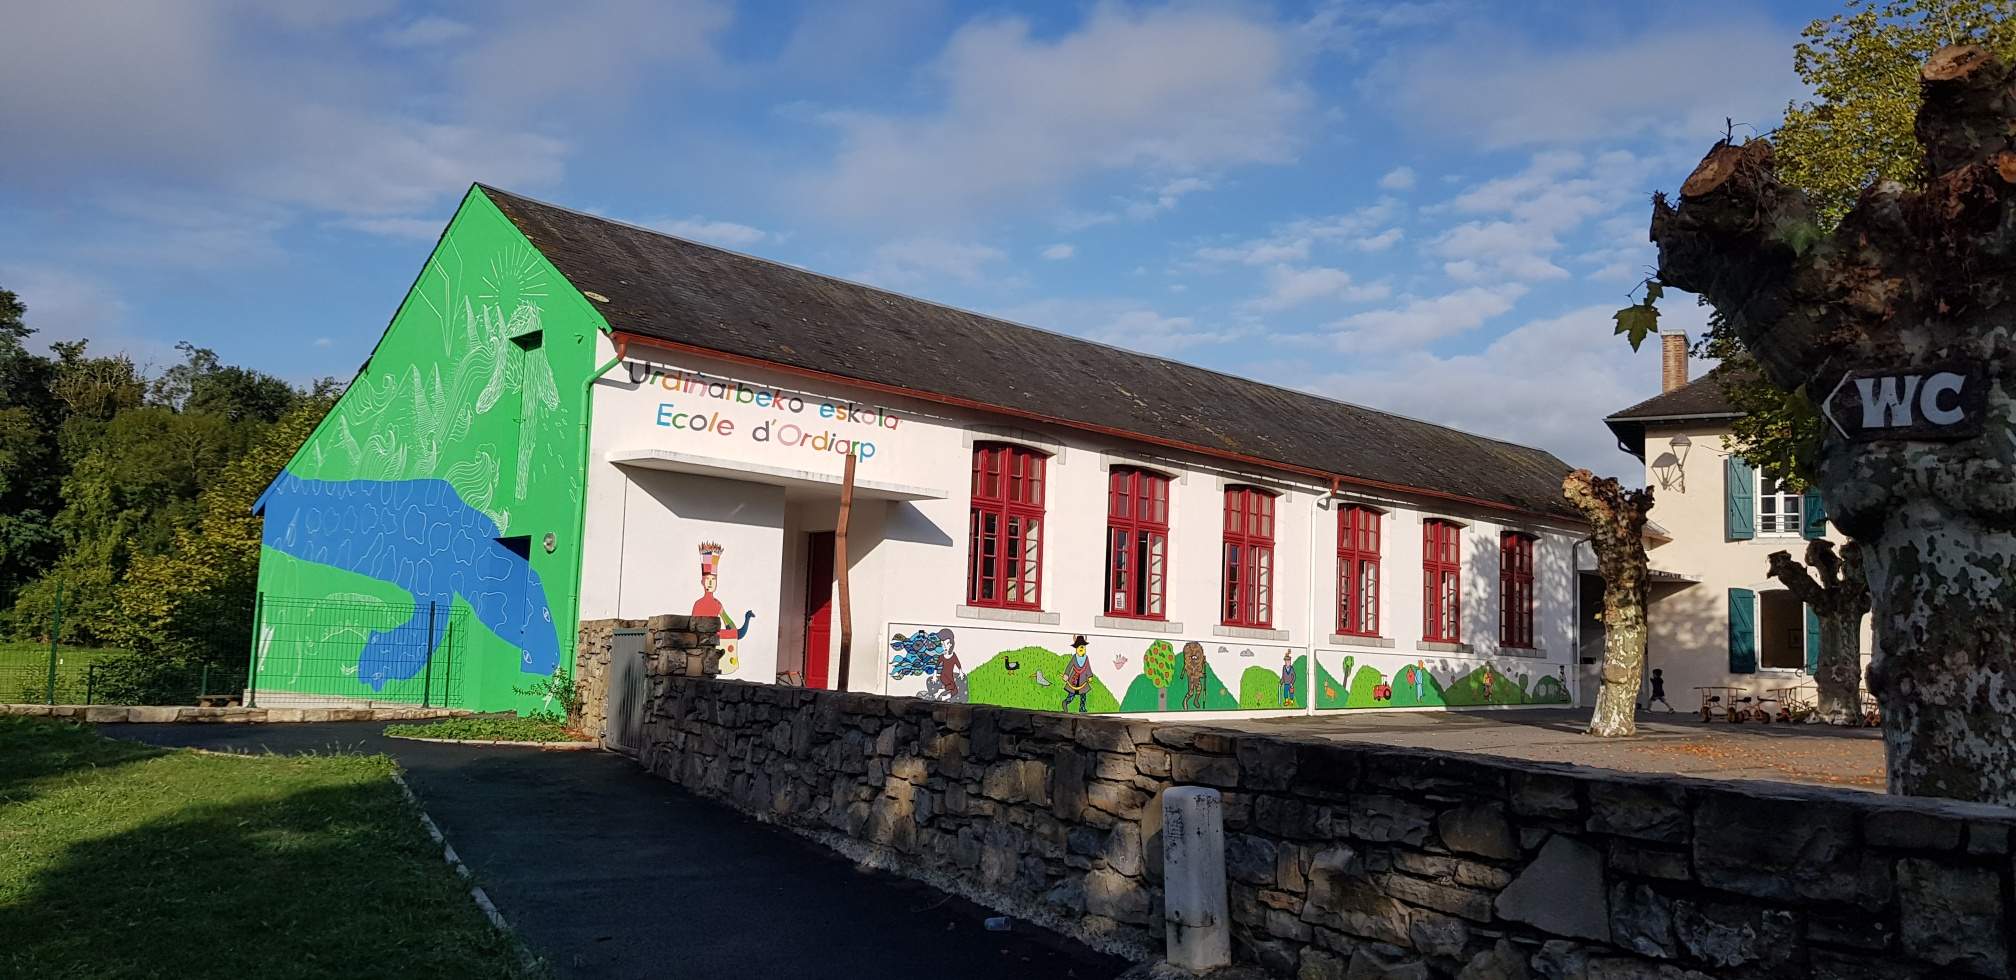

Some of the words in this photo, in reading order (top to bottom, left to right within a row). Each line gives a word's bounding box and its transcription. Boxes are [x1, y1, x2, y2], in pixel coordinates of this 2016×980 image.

[819, 402, 899, 430] eskola
[1854, 372, 1966, 428] WC
[656, 402, 735, 436] Ecole
[751, 419, 876, 463] d'Ordiarp
